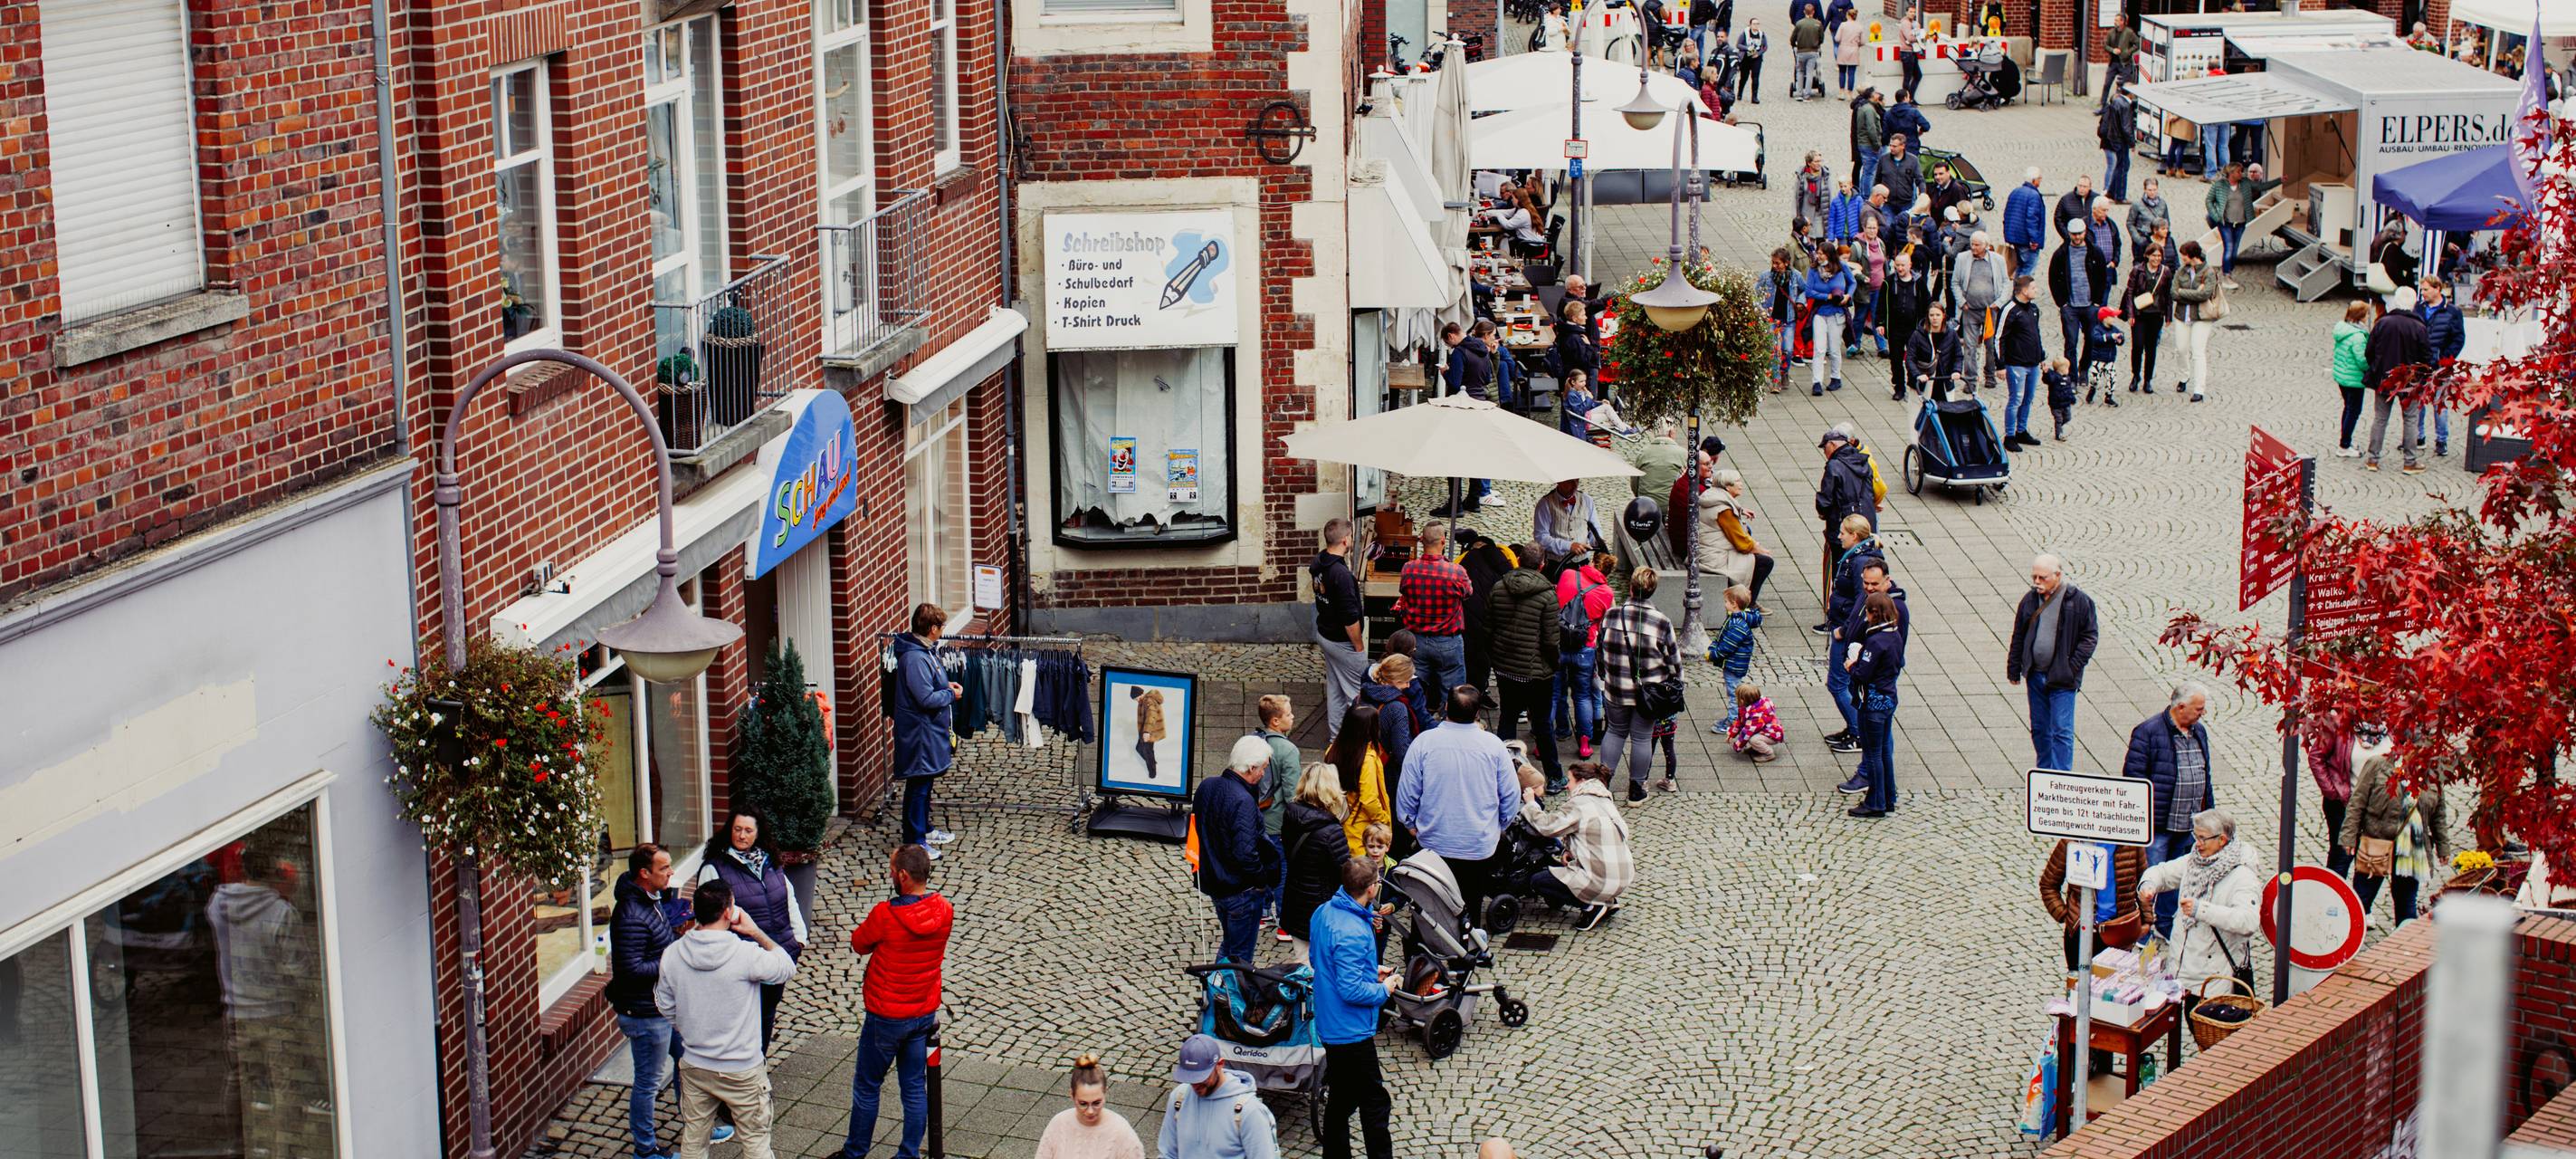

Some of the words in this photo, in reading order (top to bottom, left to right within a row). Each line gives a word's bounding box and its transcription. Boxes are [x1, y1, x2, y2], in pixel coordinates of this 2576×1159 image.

[1062, 232, 1166, 255] Schreibshop
[1102, 259, 1121, 270] und
[1065, 276, 1133, 290] Schulbedarf
[1064, 296, 1105, 311] Kopien
[1062, 315, 1102, 328] T-Shirt
[1106, 314, 1140, 327] Druck
[775, 429, 841, 549] SCHAU
[2050, 781, 2112, 795] Fahrzeugverkehr
[2116, 787, 2127, 796] für
[2037, 792, 2099, 806] Marktbeschicker
[2103, 800, 2115, 809] mit
[2119, 801, 2140, 810] Fahr-
[2033, 805, 2059, 816] zeugen
[2062, 807, 2074, 816] bis
[2077, 808, 2088, 818] 12t
[2093, 810, 2145, 823] tatsächlichem
[2038, 817, 2094, 830] Gesamtgewicht
[2098, 825, 2140, 835] zugelassen
[1233, 1046, 1268, 1058] Qeridoo
